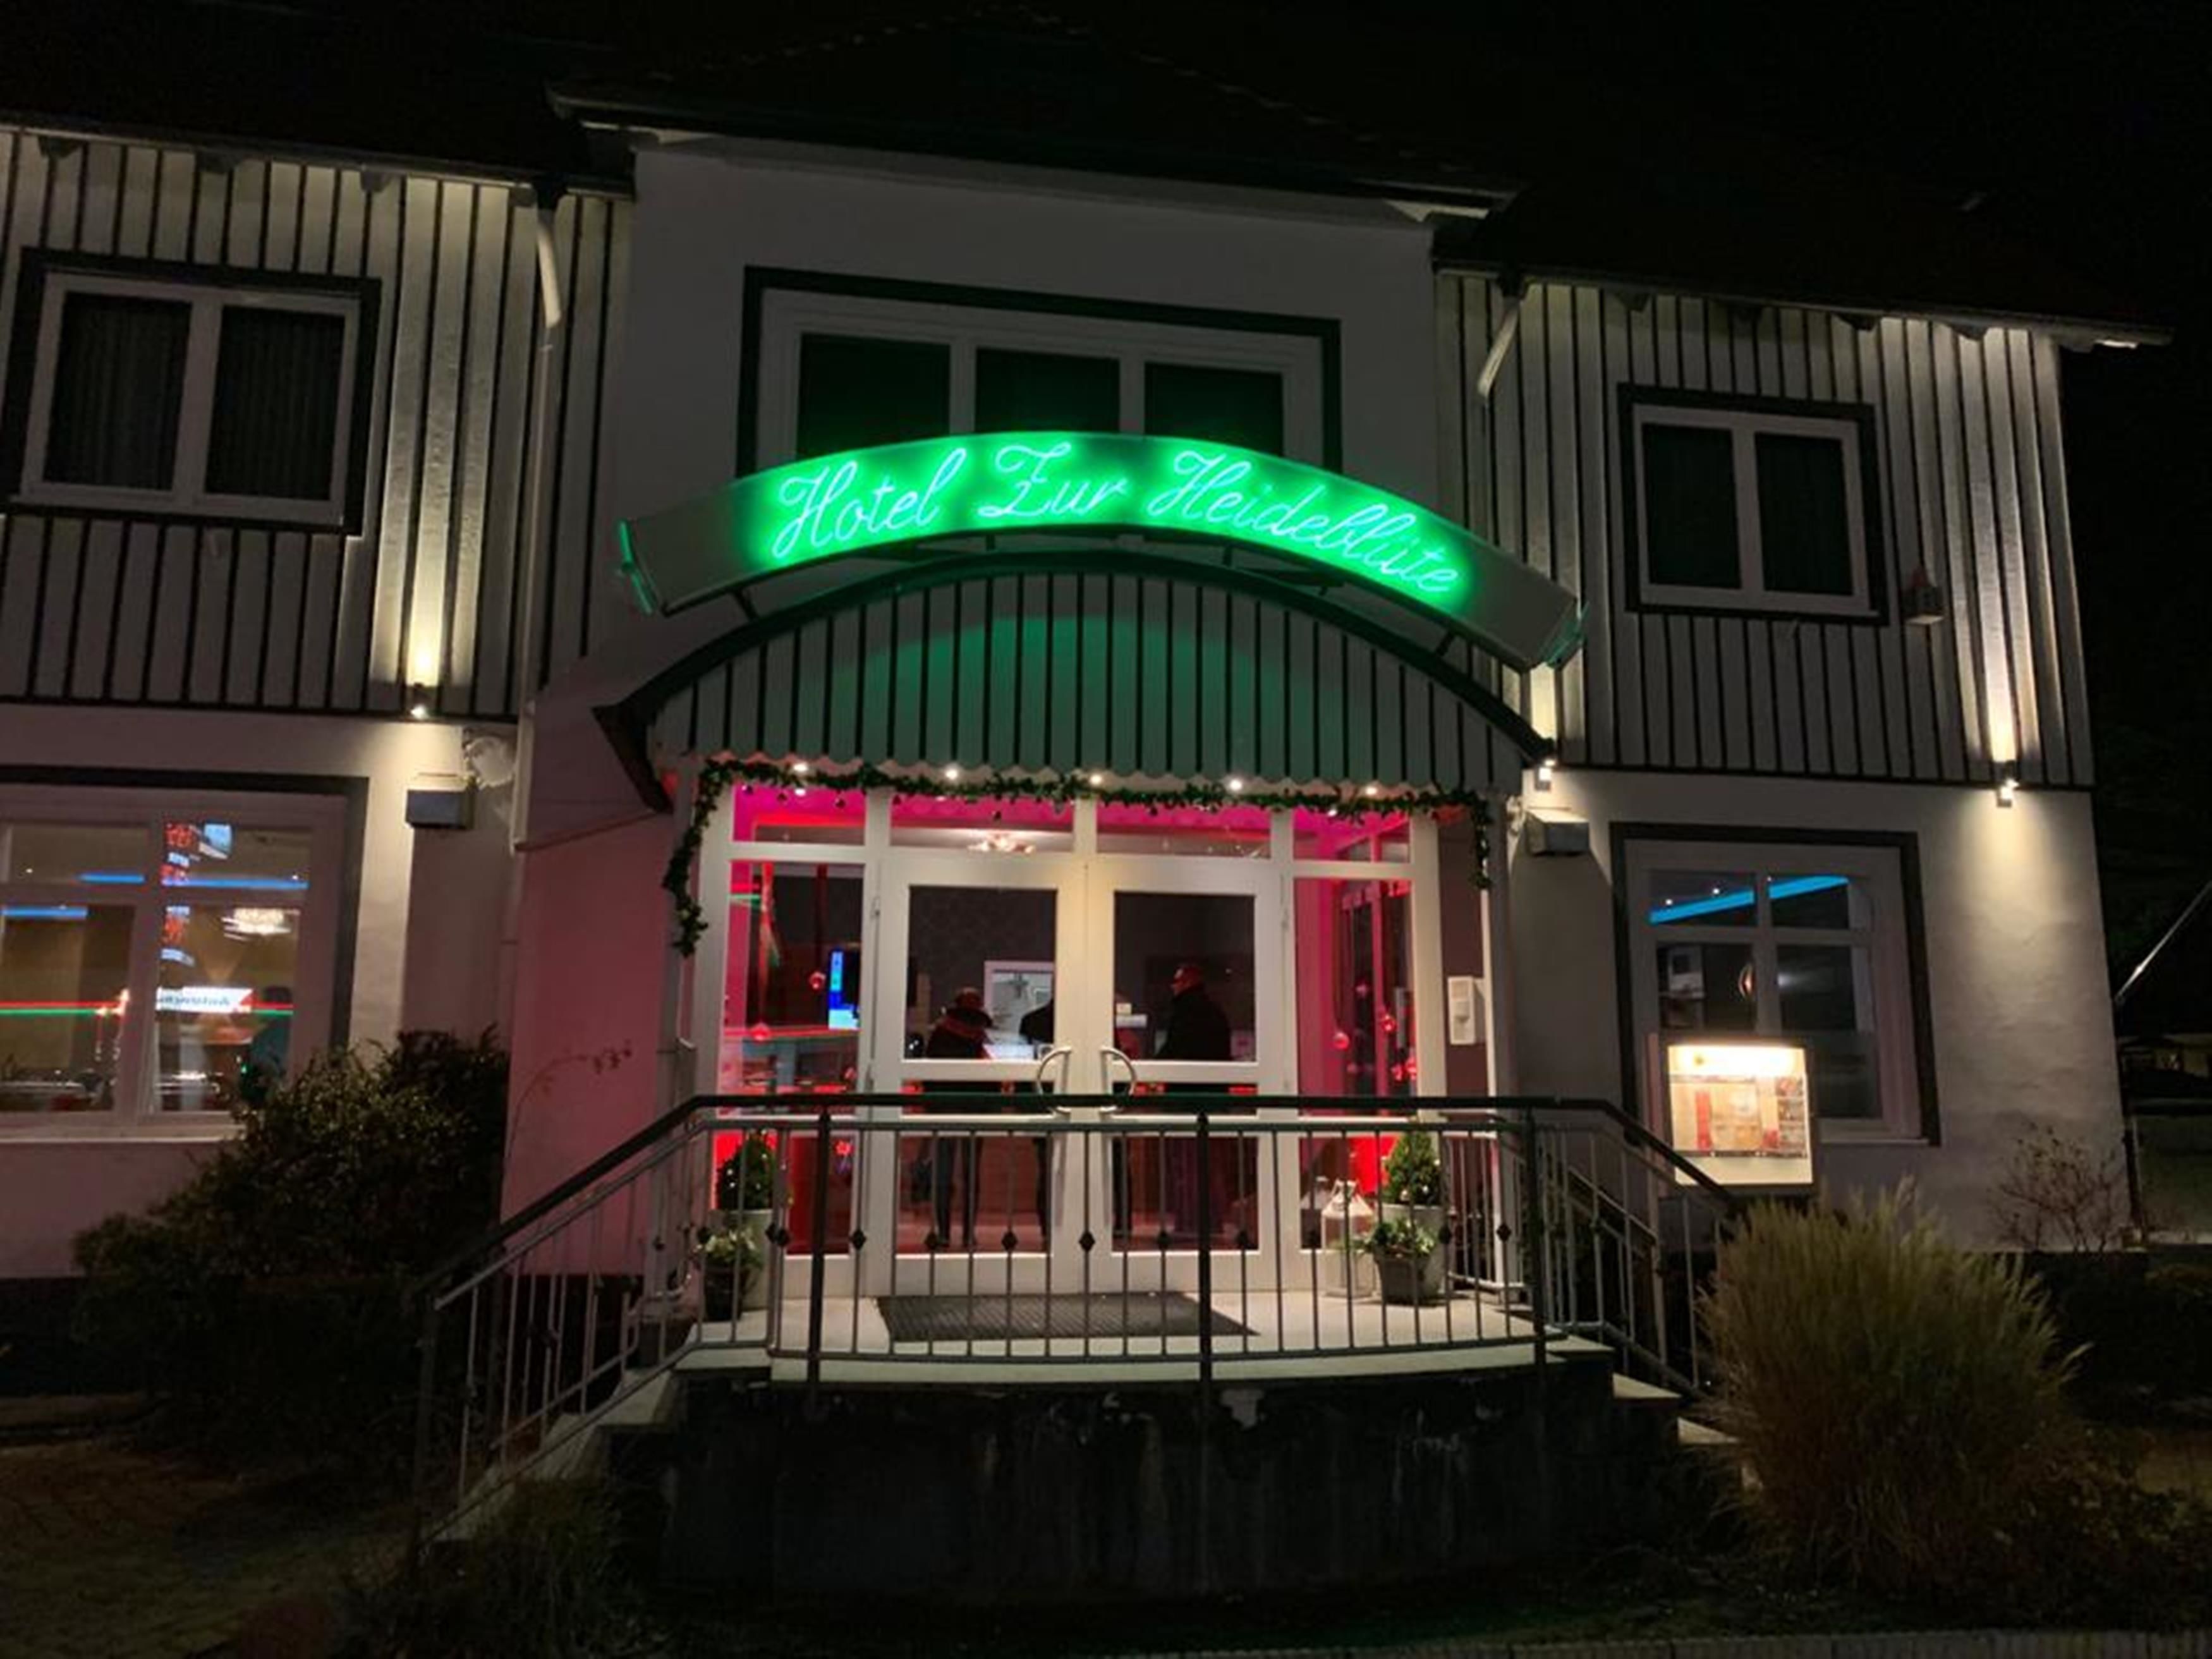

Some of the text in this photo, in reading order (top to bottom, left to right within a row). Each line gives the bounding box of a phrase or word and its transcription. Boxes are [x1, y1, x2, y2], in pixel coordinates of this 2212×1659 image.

[772, 441, 1458, 593] Hotel Zur Heideblüte
